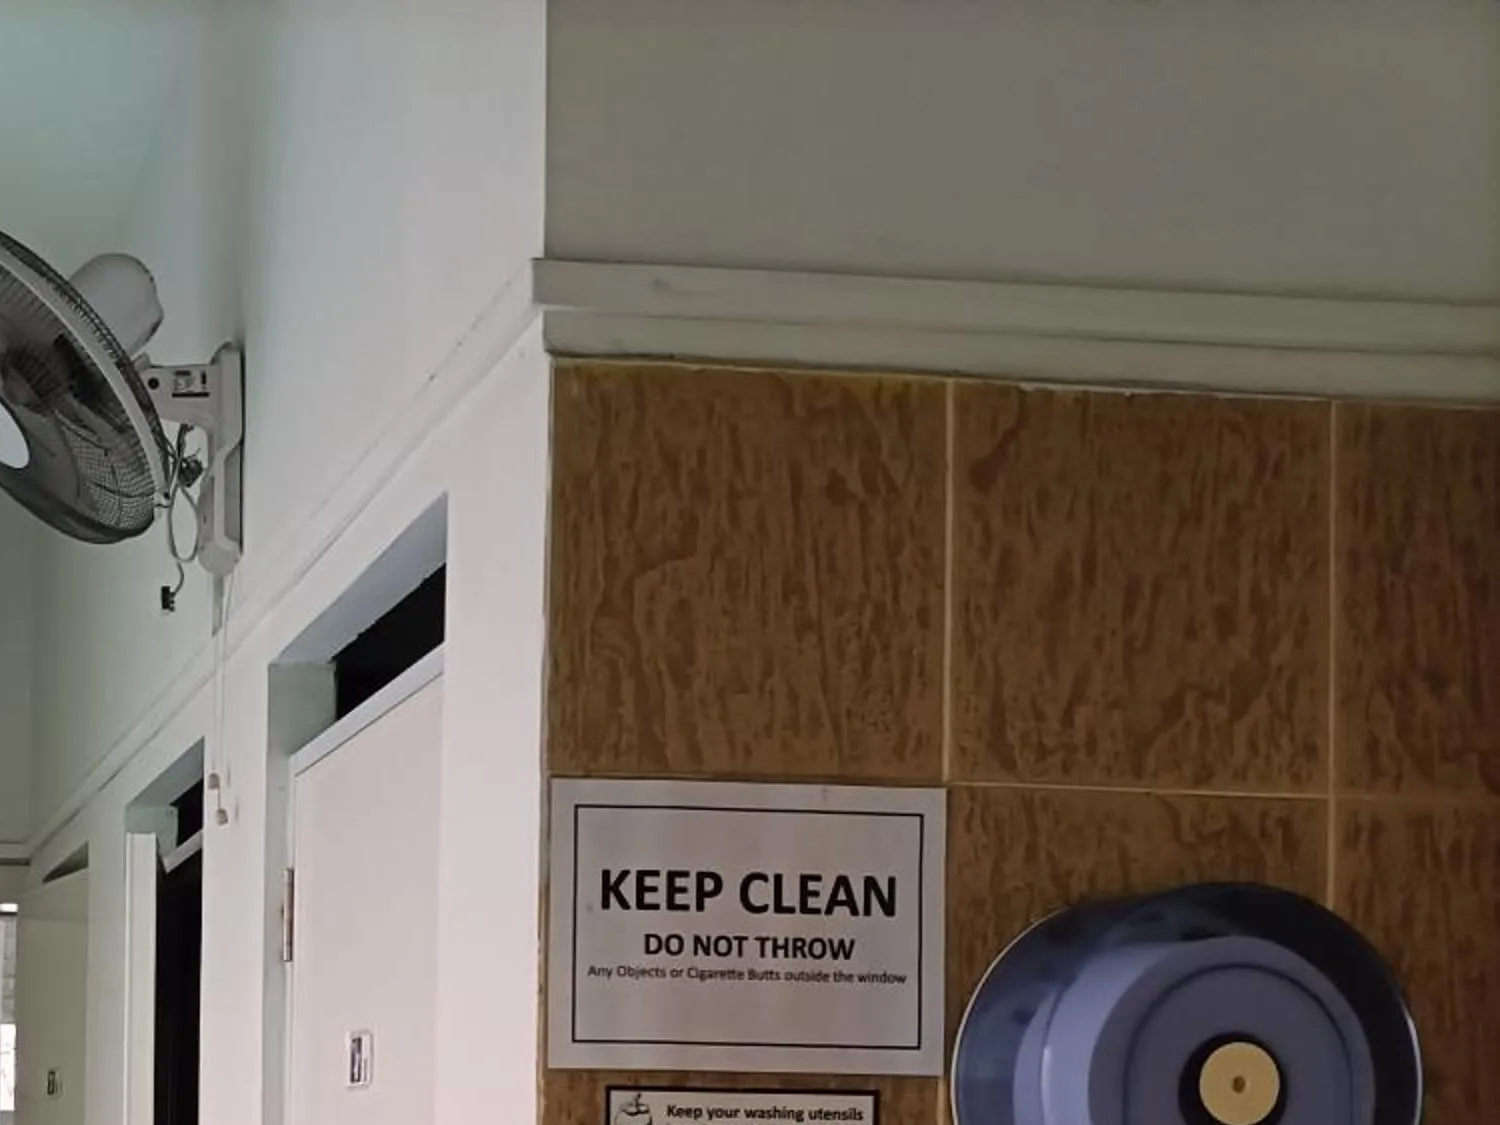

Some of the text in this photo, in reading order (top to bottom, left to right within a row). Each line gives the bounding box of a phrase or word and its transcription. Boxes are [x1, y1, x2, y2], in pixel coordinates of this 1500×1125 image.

[601, 869, 897, 917] KEEP CLEAN
[644, 933, 856, 960] DO NOT THROW
[587, 965, 907, 984] Any Objects or Cigarette Butts outside the window
[667, 1104, 864, 1122] Keep your washing utensils
